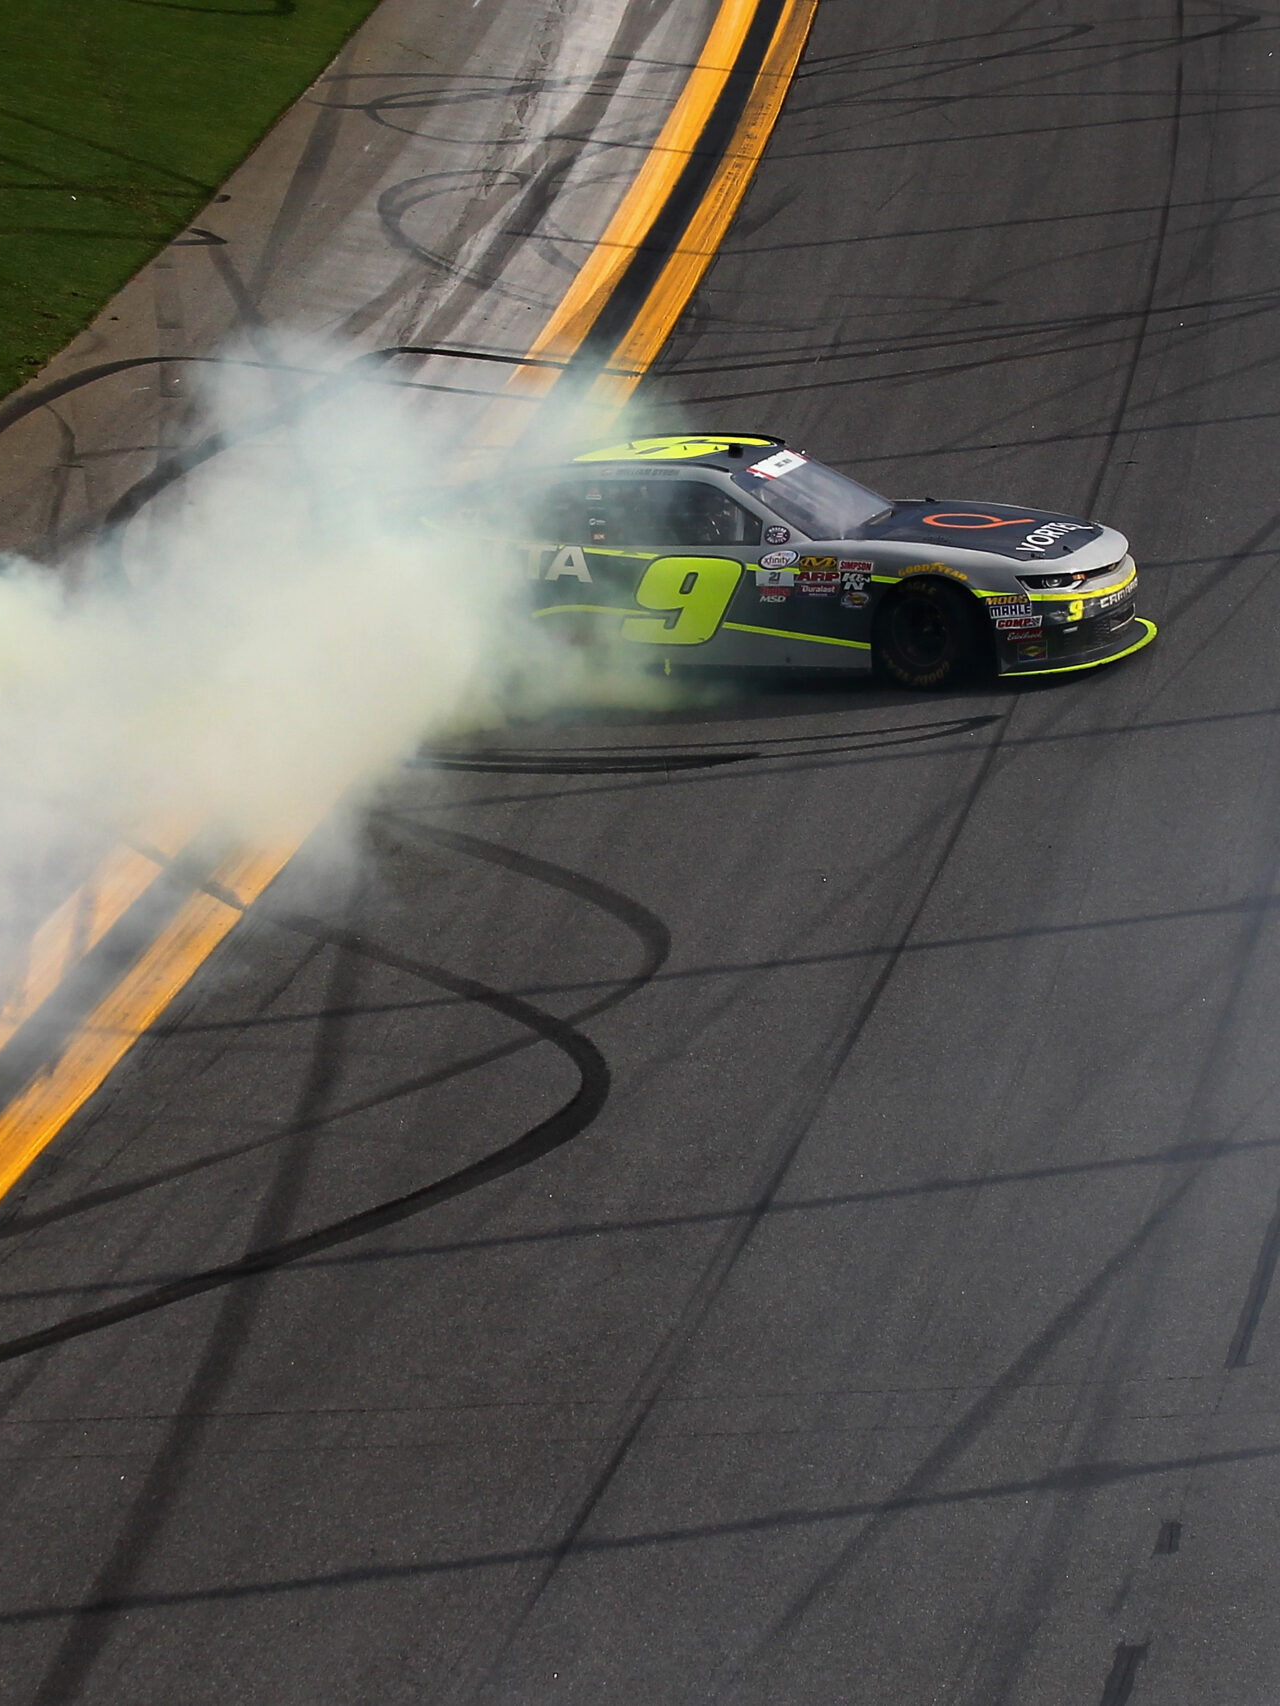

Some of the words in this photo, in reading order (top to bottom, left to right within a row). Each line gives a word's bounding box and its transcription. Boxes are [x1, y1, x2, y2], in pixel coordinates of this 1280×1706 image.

[841, 561, 872, 571] SIMPSON
[798, 572, 840, 581] ARP
[801, 585, 836, 593] Duralast
[620, 555, 746, 645] 9
[760, 595, 786, 603] MSD
[986, 594, 1028, 605] MOOG
[990, 605, 1031, 617] MAHLE
[1066, 600, 1084, 621] 9
[997, 618, 1032, 628] COMP
